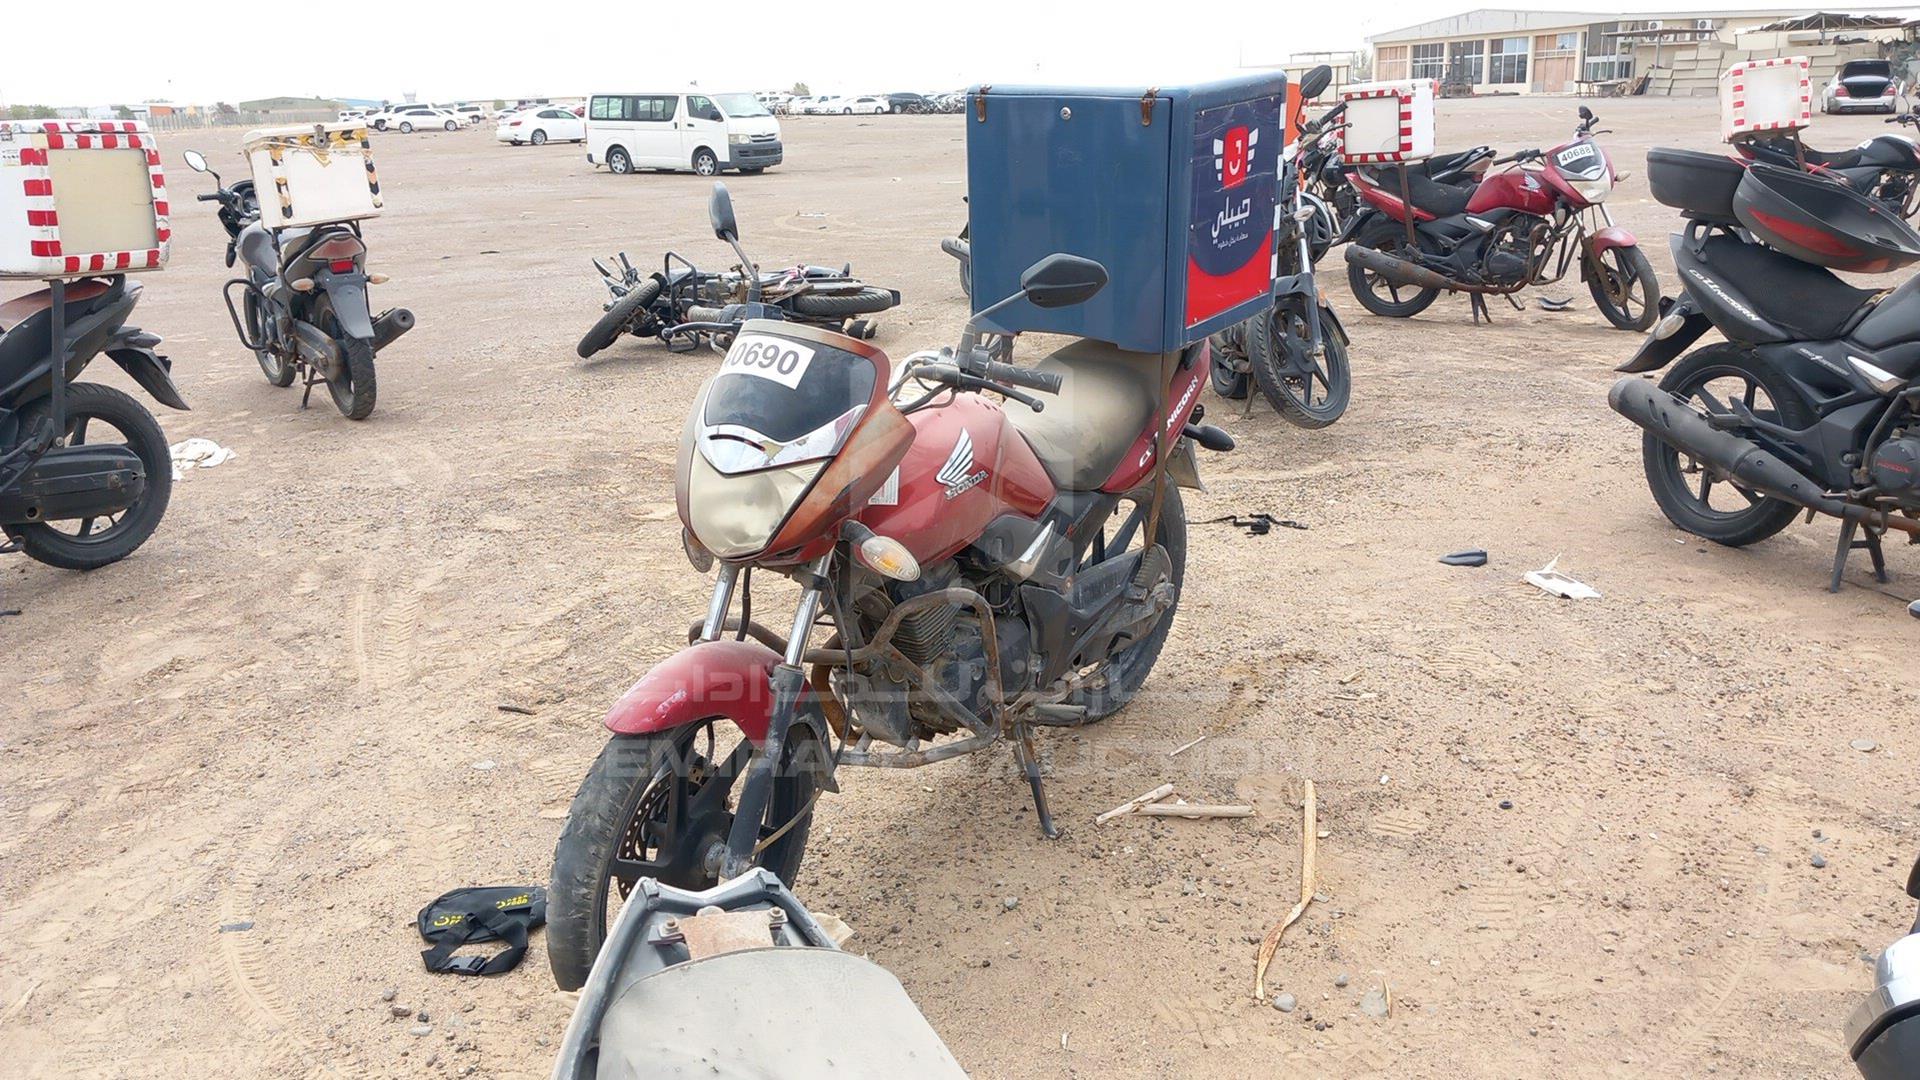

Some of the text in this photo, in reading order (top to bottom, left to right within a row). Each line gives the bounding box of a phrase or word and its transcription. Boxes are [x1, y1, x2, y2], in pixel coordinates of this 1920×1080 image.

[1211, 196, 1251, 246] جيبلي
[726, 342, 800, 376] 0690
[1153, 375, 1200, 441] NICORN
[944, 470, 989, 501] HONDA
